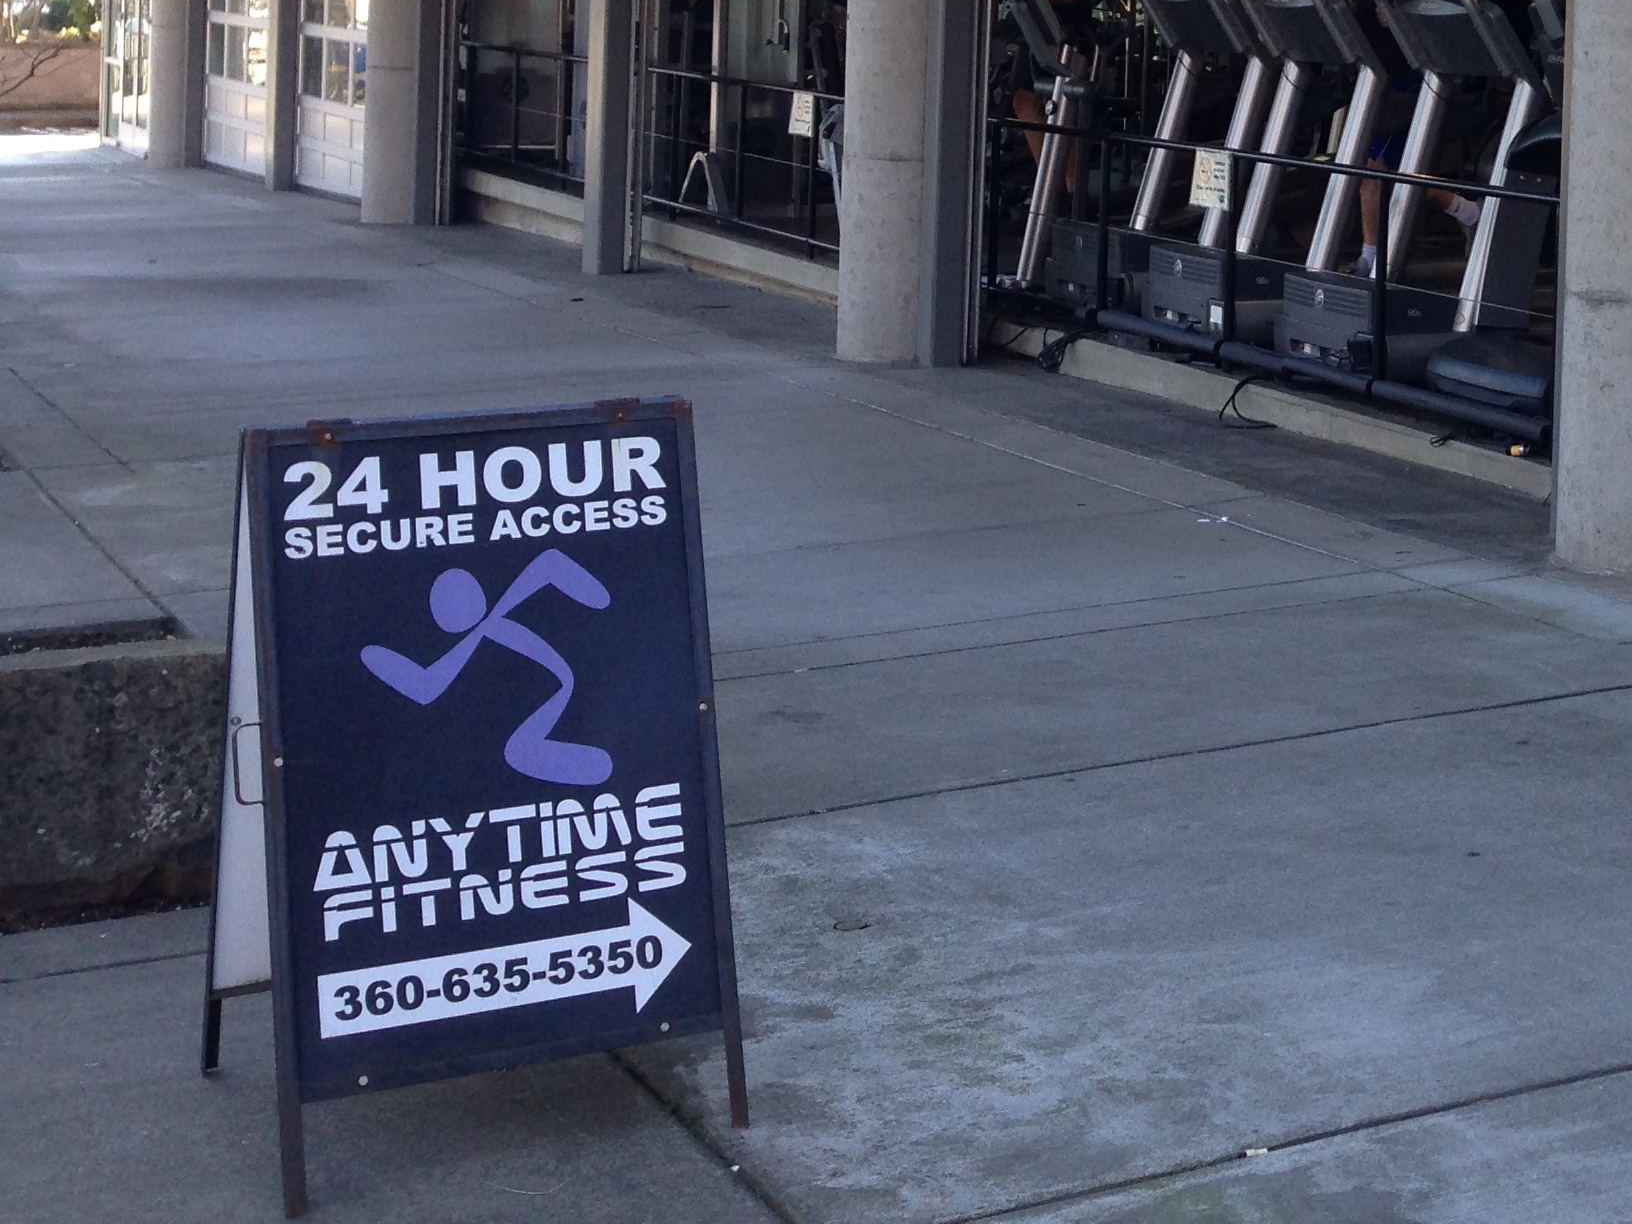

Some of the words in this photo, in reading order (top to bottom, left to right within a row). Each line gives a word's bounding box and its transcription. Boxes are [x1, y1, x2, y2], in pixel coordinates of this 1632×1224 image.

[283, 456, 389, 521] 24
[418, 436, 667, 510] HOUR
[284, 512, 475, 559] SECURE
[489, 495, 668, 542] ACCESS
[313, 782, 685, 892] ANYTIME
[323, 841, 687, 943] FITNESS
[333, 935, 663, 1021] 360-635-5350
